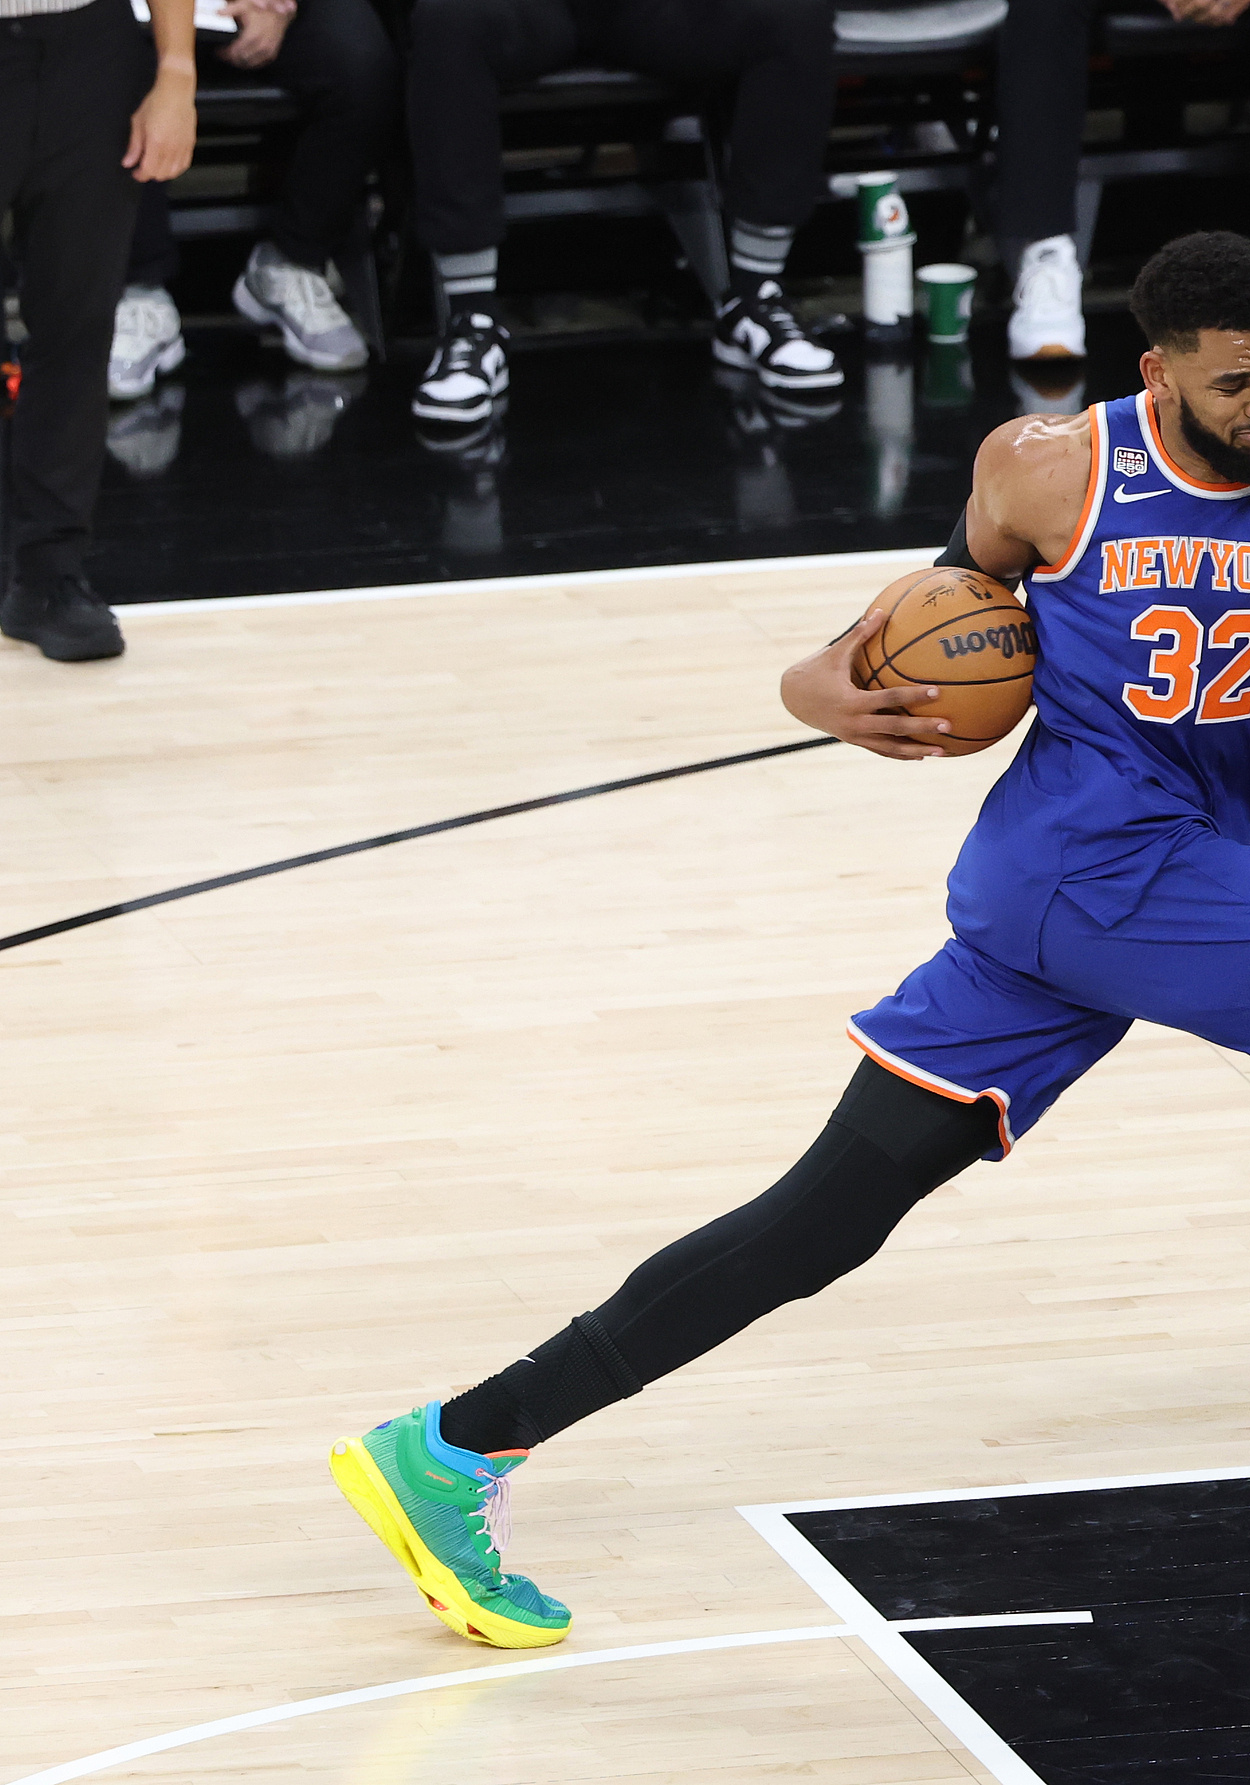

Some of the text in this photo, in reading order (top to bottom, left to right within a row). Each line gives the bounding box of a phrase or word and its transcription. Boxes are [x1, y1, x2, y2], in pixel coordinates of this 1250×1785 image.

[1118, 450, 1144, 461] USA
[1117, 461, 1144, 472] 250
[1099, 536, 1208, 594] NEW
